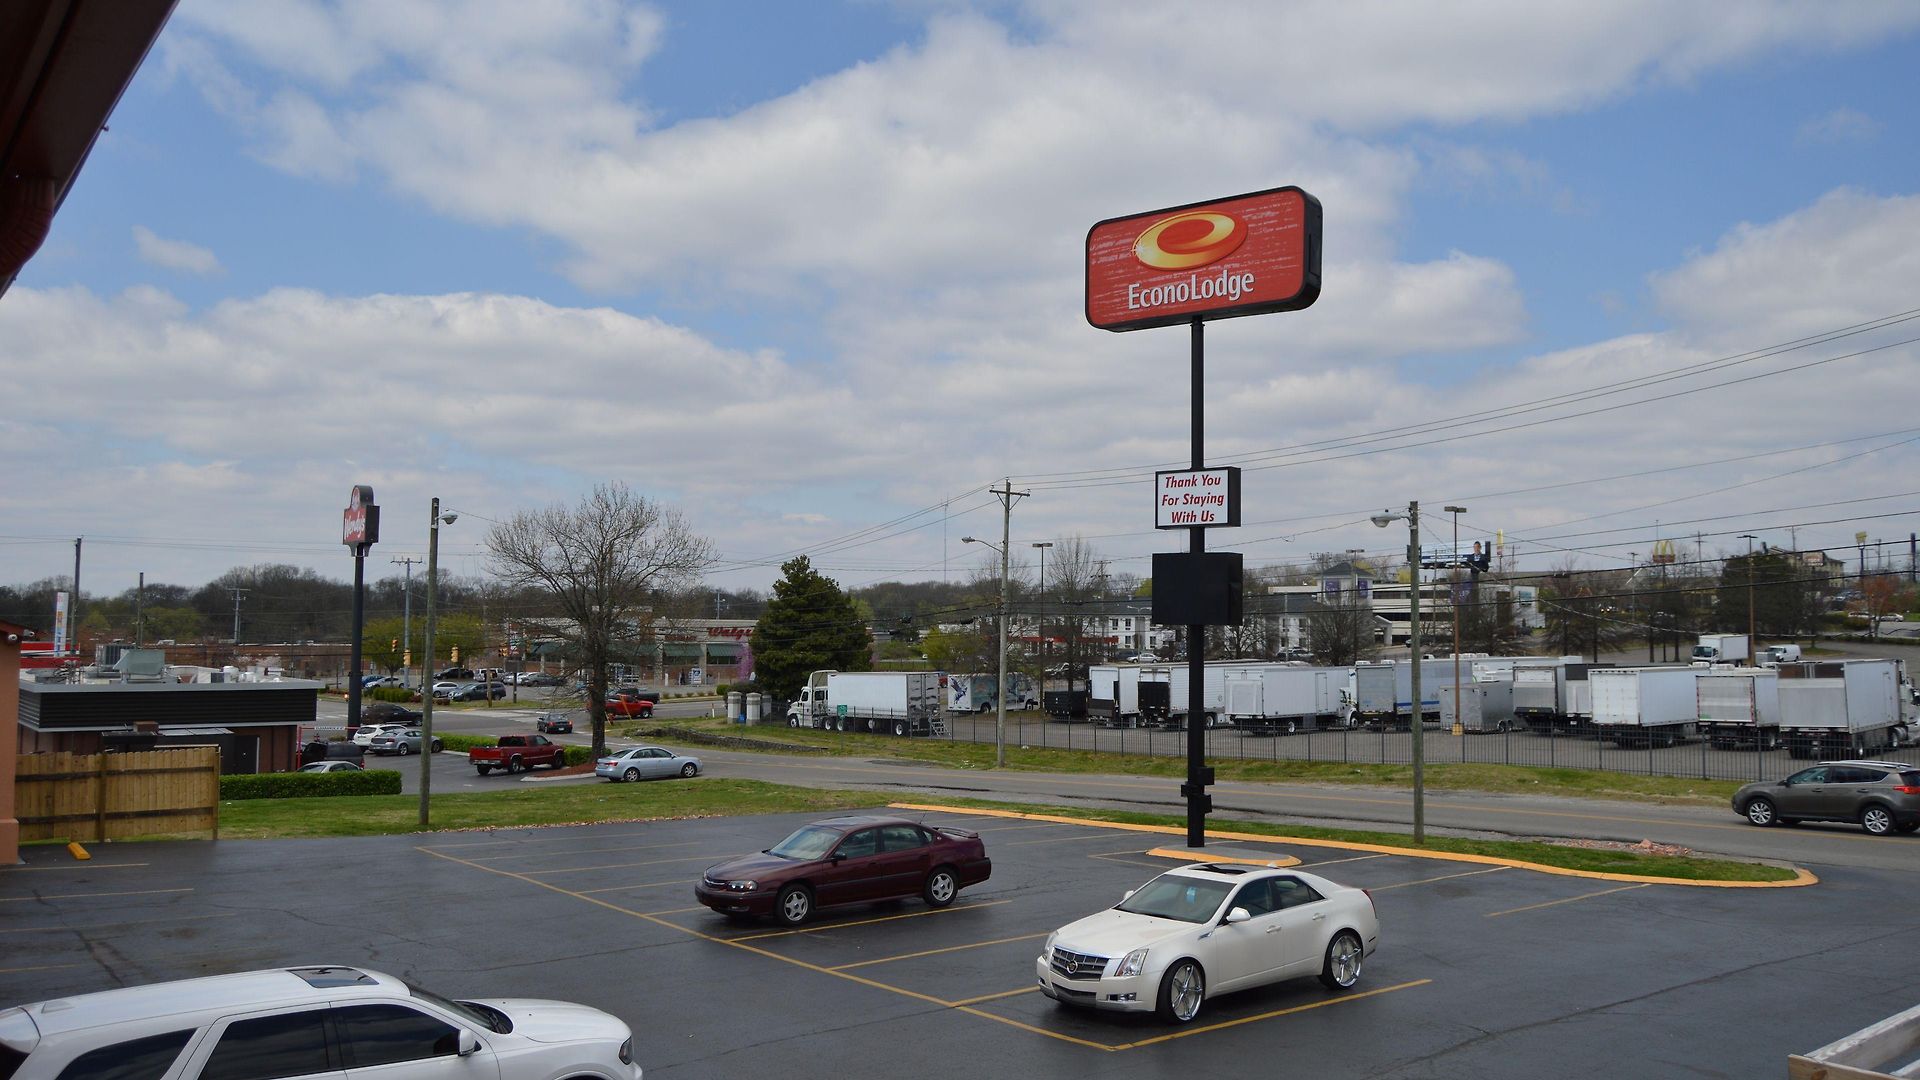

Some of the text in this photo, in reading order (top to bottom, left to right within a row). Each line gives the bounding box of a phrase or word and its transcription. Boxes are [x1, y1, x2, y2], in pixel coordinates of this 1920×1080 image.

[1128, 270, 1254, 309] EconoLodge
[1165, 475, 1221, 488] Thank You
[1162, 493, 1224, 507] For Staying
[1172, 511, 1214, 523] With Us
[708, 627, 752, 639] Walgr
